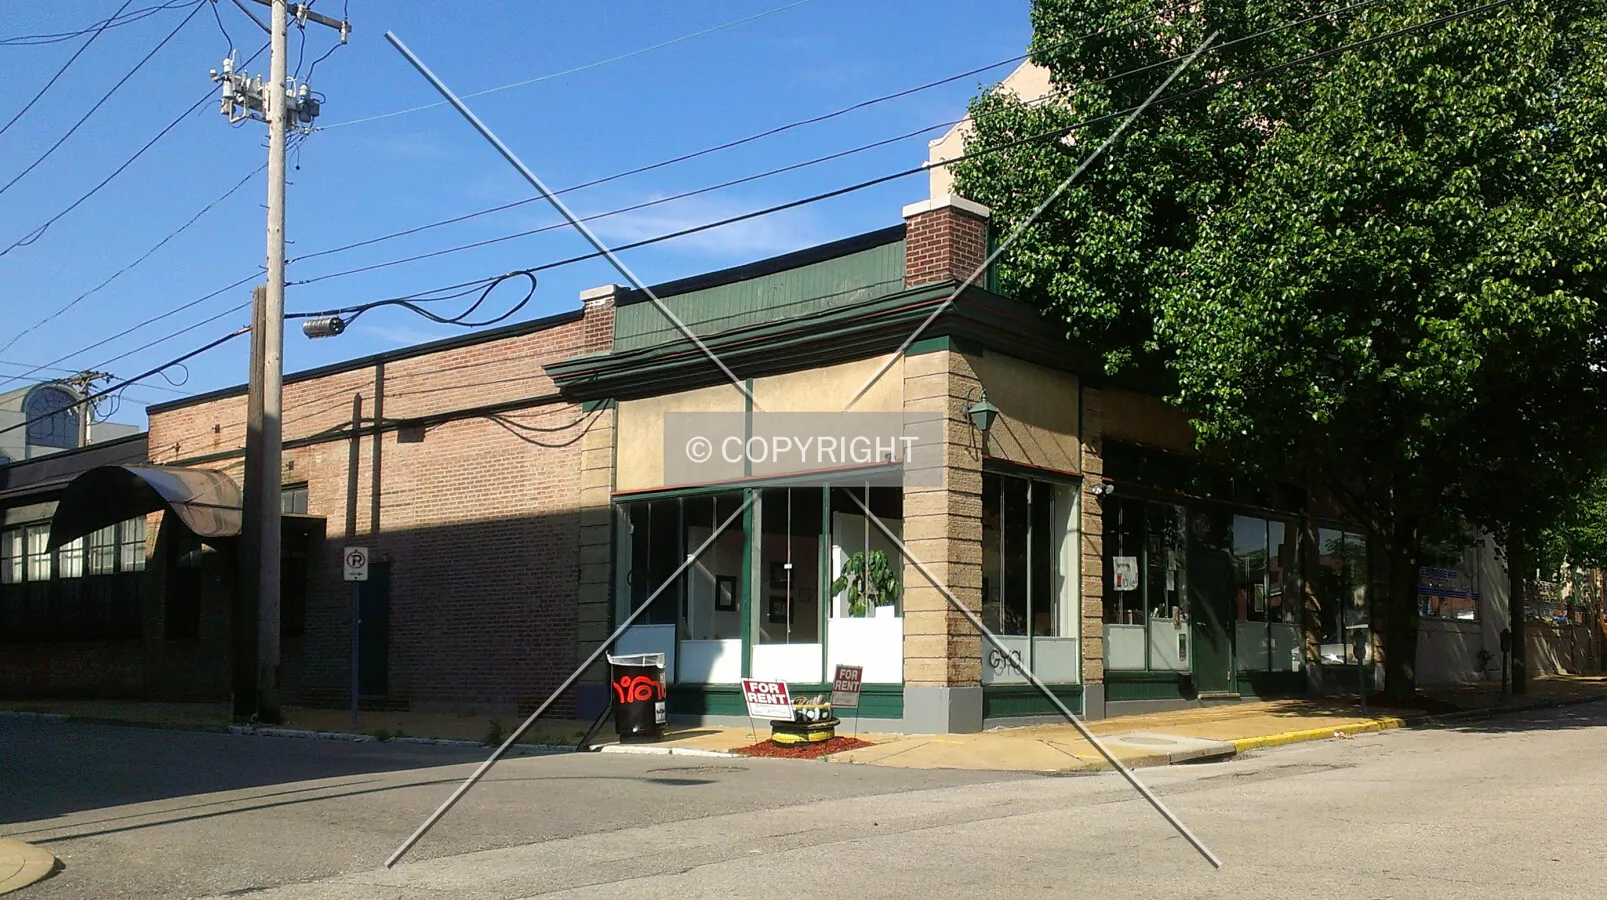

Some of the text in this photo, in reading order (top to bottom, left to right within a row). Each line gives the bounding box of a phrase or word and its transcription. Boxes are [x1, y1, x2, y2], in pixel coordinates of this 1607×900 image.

[839, 668, 859, 680] FOR
[748, 682, 780, 693] FOR
[834, 680, 860, 692] RENT
[747, 693, 786, 705] RENT
